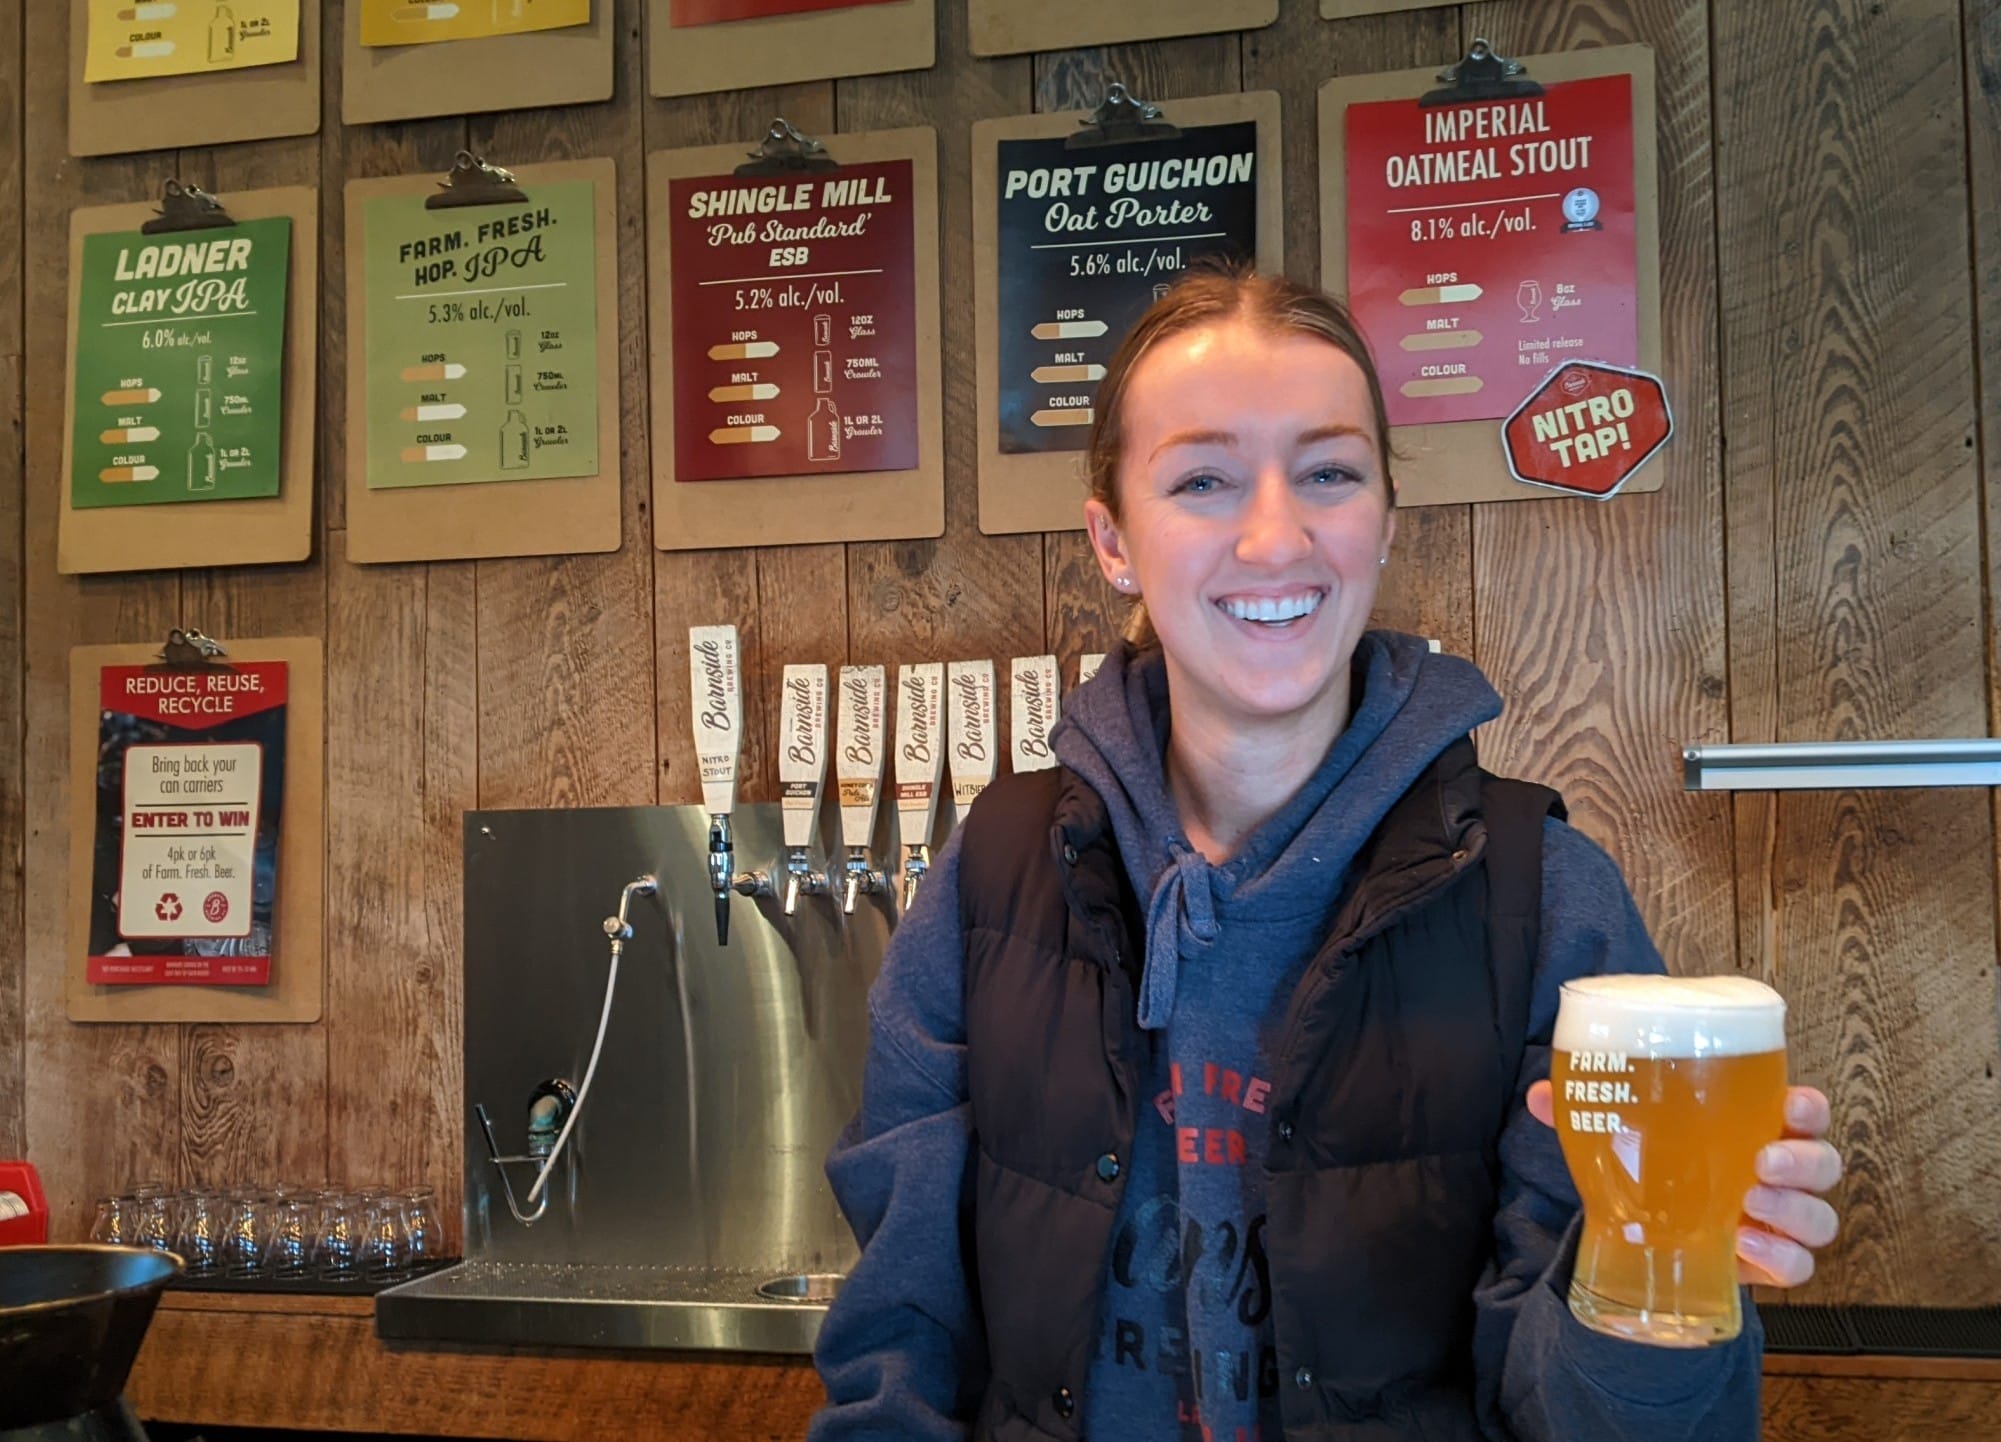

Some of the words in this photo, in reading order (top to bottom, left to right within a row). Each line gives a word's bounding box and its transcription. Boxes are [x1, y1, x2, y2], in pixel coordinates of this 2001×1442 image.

[129, 31, 161, 42] COLOUR
[1425, 101, 1550, 144] IMPERIAL
[1386, 147, 1502, 188] OATMEAL
[1510, 136, 1593, 176] STOUT
[1004, 166, 1097, 200] PORT
[1103, 152, 1254, 194] GUICHON
[688, 183, 814, 219] SHINGLE
[821, 176, 893, 208] MILL
[1045, 202, 1098, 232] Oat
[1105, 197, 1213, 229] Porter
[1411, 216, 1455, 242] 8.1%
[1460, 207, 1537, 240] alc./vol.
[399, 231, 469, 263] FARM.
[478, 208, 558, 244] FRESH.
[114, 238, 253, 282] LADNER
[415, 259, 457, 287] HOP.
[463, 234, 546, 283] IPA
[768, 246, 810, 267] ESB
[1069, 253, 1110, 276] 5.6%
[1116, 247, 1186, 276] alc./vol.
[1426, 272, 1458, 285] HOPS
[111, 288, 172, 315] CLAY
[171, 277, 250, 315] IPA
[735, 288, 773, 311] 5.2%
[778, 281, 844, 310] alc./vol.
[428, 303, 464, 324] 5.3%
[469, 296, 531, 324] alc./vol.
[1056, 309, 1085, 320] HOPS
[849, 325, 876, 340] Glass
[1426, 318, 1460, 330] MALT
[142, 328, 175, 349] 6.0%
[731, 330, 758, 342] HOPS
[1518, 339, 1551, 351] Limited
[1552, 337, 1584, 349] release
[422, 353, 446, 363] HOPS
[846, 358, 880, 368] 750ML
[1055, 352, 1085, 363] MALT
[1519, 354, 1531, 366] No
[1533, 353, 1549, 364] fills
[731, 372, 759, 383] MALT
[844, 368, 882, 379] Crowler
[1421, 364, 1467, 377] COLOUR
[120, 378, 143, 389] HOPS
[421, 393, 446, 403] MALT
[1049, 396, 1090, 407] COLOUR
[118, 416, 143, 427] MALT
[727, 414, 765, 425] COLOUR
[844, 416, 854, 425] 1L
[855, 415, 869, 425] OR
[871, 414, 883, 424] 2L
[1532, 388, 1635, 443] NITRO
[416, 433, 452, 444] COLOUR
[844, 426, 883, 440] Growler
[1550, 422, 1631, 469] TAP!
[112, 455, 146, 466] COLOUR
[726, 653, 735, 693] BREWING
[126, 676, 201, 695] REDUCE,
[207, 674, 265, 693] REUSE,
[693, 640, 731, 731] Barnside
[158, 696, 233, 714] RECYCLE
[815, 691, 823, 729] BREWING
[930, 688, 938, 726] BREWING
[982, 684, 990, 724] BREWING
[1045, 680, 1053, 720] BREWING
[787, 677, 816, 766] Barnside
[844, 678, 873, 765] Barnside
[902, 676, 931, 764] Barnside
[952, 673, 986, 761] Barnside
[1015, 669, 1049, 758] Barnside
[152, 755, 180, 776] Bring
[184, 754, 209, 771] back
[212, 757, 237, 774] your
[702, 755, 730, 765] NITRO
[702, 766, 732, 777] STOUT
[160, 779, 180, 794] can
[183, 776, 224, 793] carriers
[131, 812, 189, 828] ENTER
[193, 811, 214, 827] TO
[219, 811, 250, 827] WIN
[167, 846, 185, 864] 4pk
[188, 849, 197, 861] or
[199, 846, 217, 863] 6pk
[142, 865, 153, 880] of
[155, 864, 182, 880] Farm.
[185, 864, 211, 879] Fresh.
[214, 864, 236, 879] Beer.
[1569, 1051, 1635, 1073] FARM.
[1565, 1080, 1638, 1104] FRESH.
[1569, 1110, 1629, 1134] BEER.
